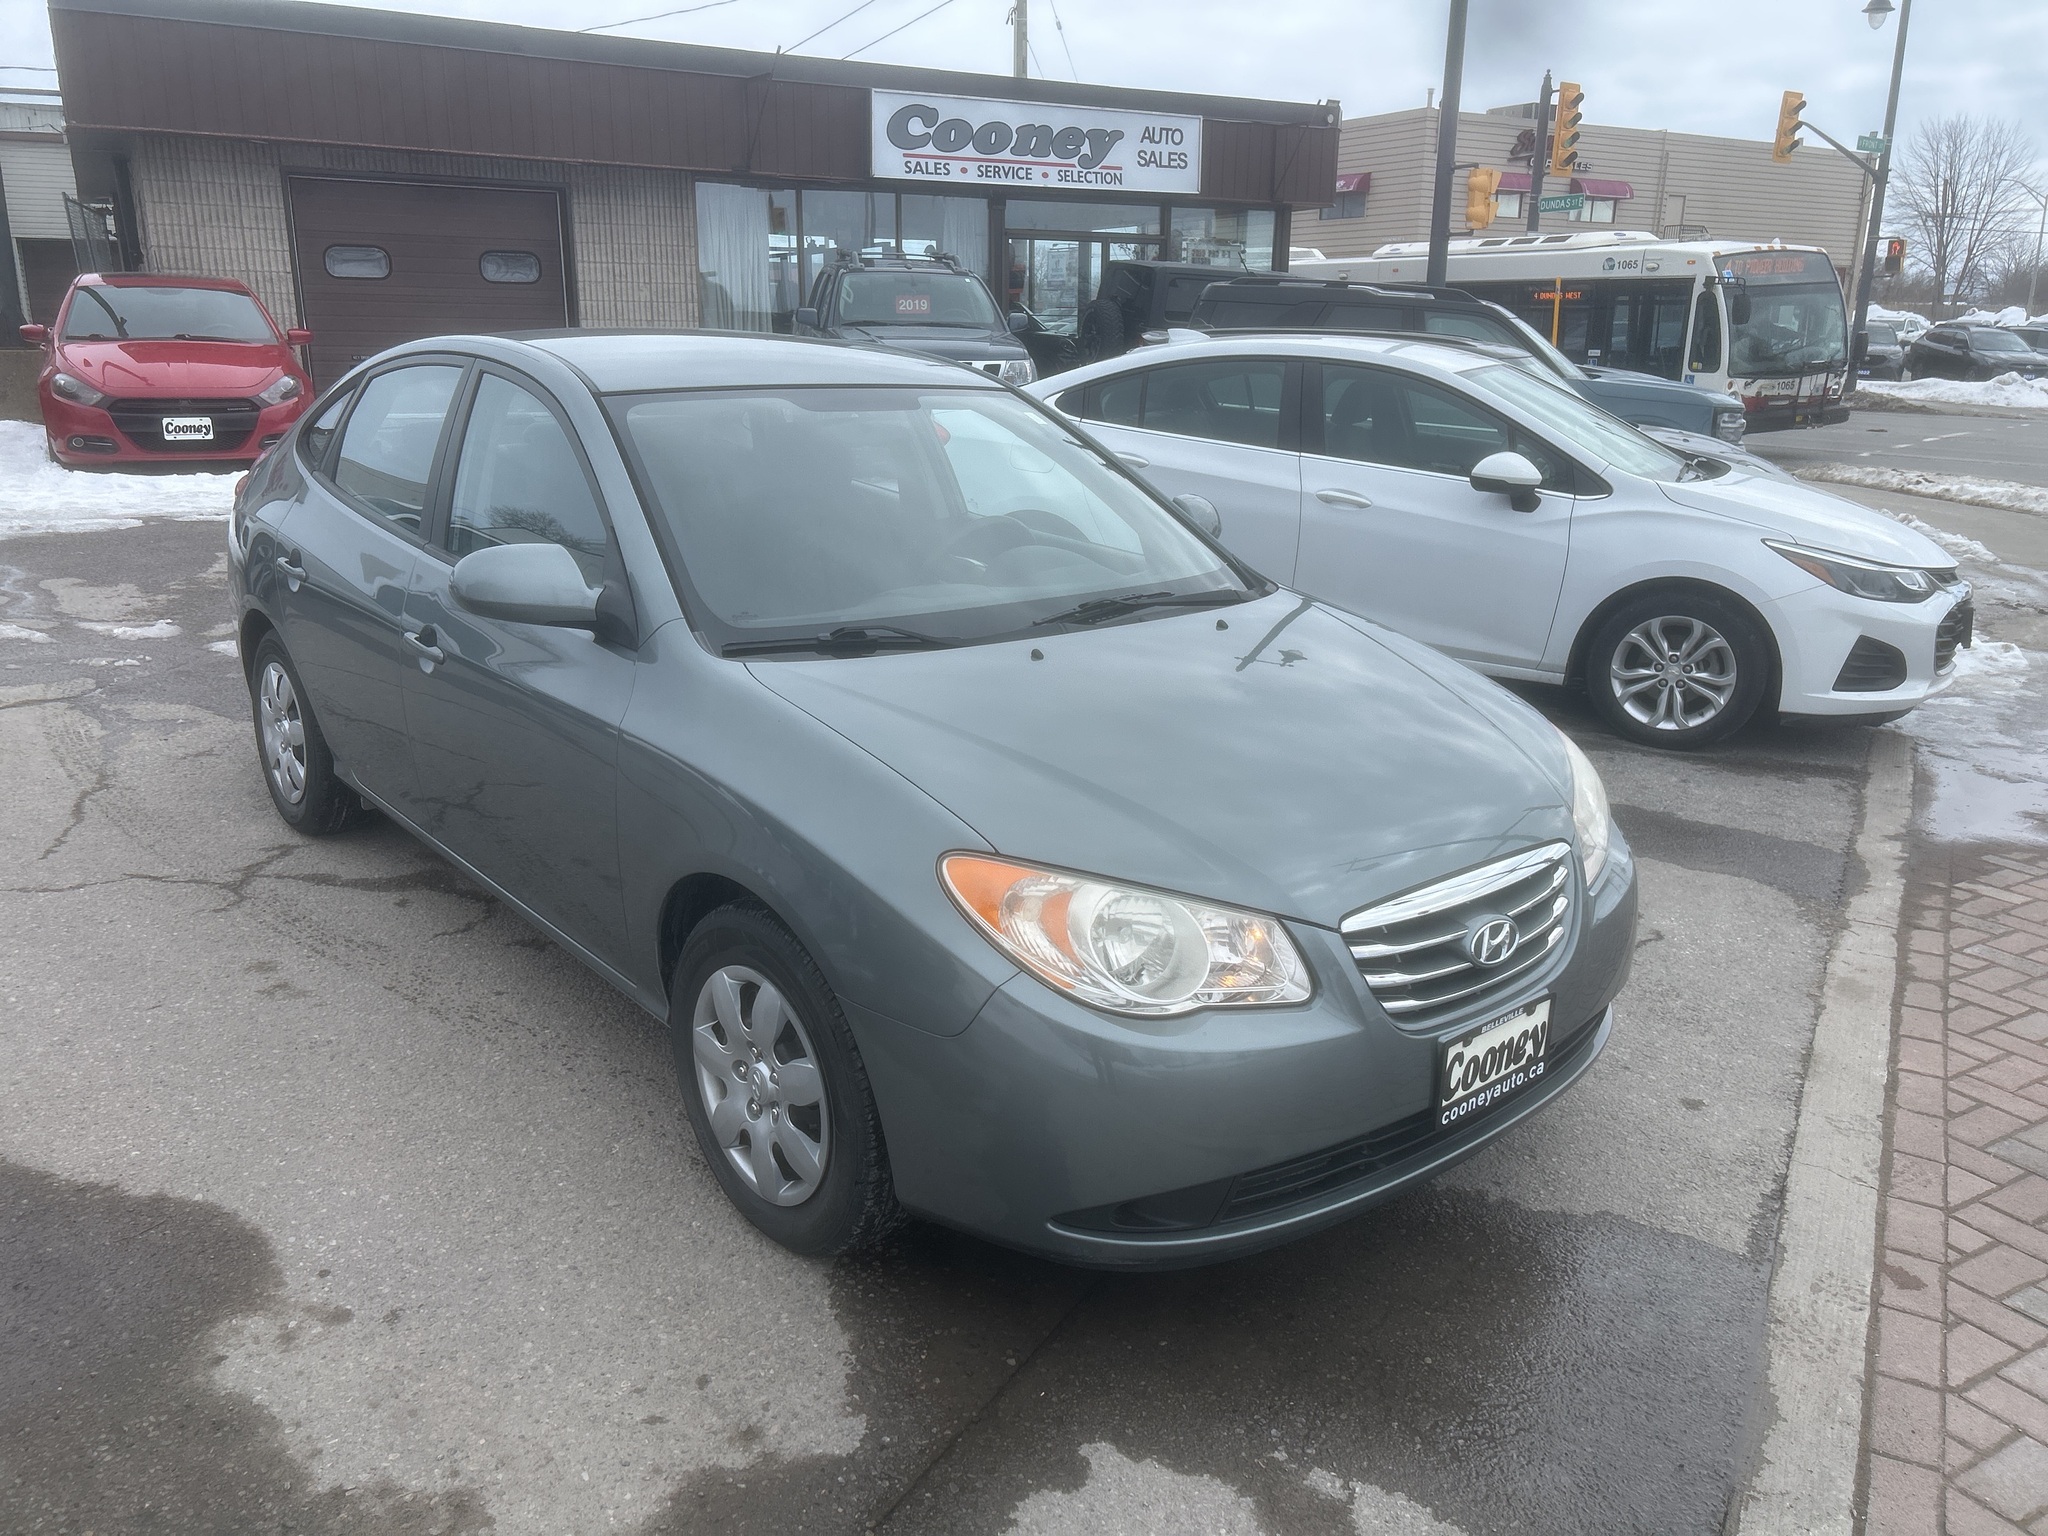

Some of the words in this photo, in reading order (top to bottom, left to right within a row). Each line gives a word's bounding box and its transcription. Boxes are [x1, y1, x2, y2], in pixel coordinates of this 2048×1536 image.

[887, 103, 1125, 170] Cooney
[1139, 125, 1184, 146] AUTO
[1136, 149, 1189, 170] SALES
[904, 160, 951, 176] SALES
[977, 164, 1033, 181] SERVICE
[1057, 169, 1123, 185] SELECTION
[1540, 198, 1571, 210] DUNDAS
[1578, 197, 1584, 207] E
[1617, 259, 1639, 270] 1065
[898, 299, 929, 311] 2019
[1776, 380, 1795, 391] 1065
[165, 421, 211, 437] Cooney
[1481, 1007, 1524, 1034] BELLEVILLE
[1442, 1020, 1548, 1103] Cooney
[1441, 1061, 1545, 1125] cooneyauto.ca
